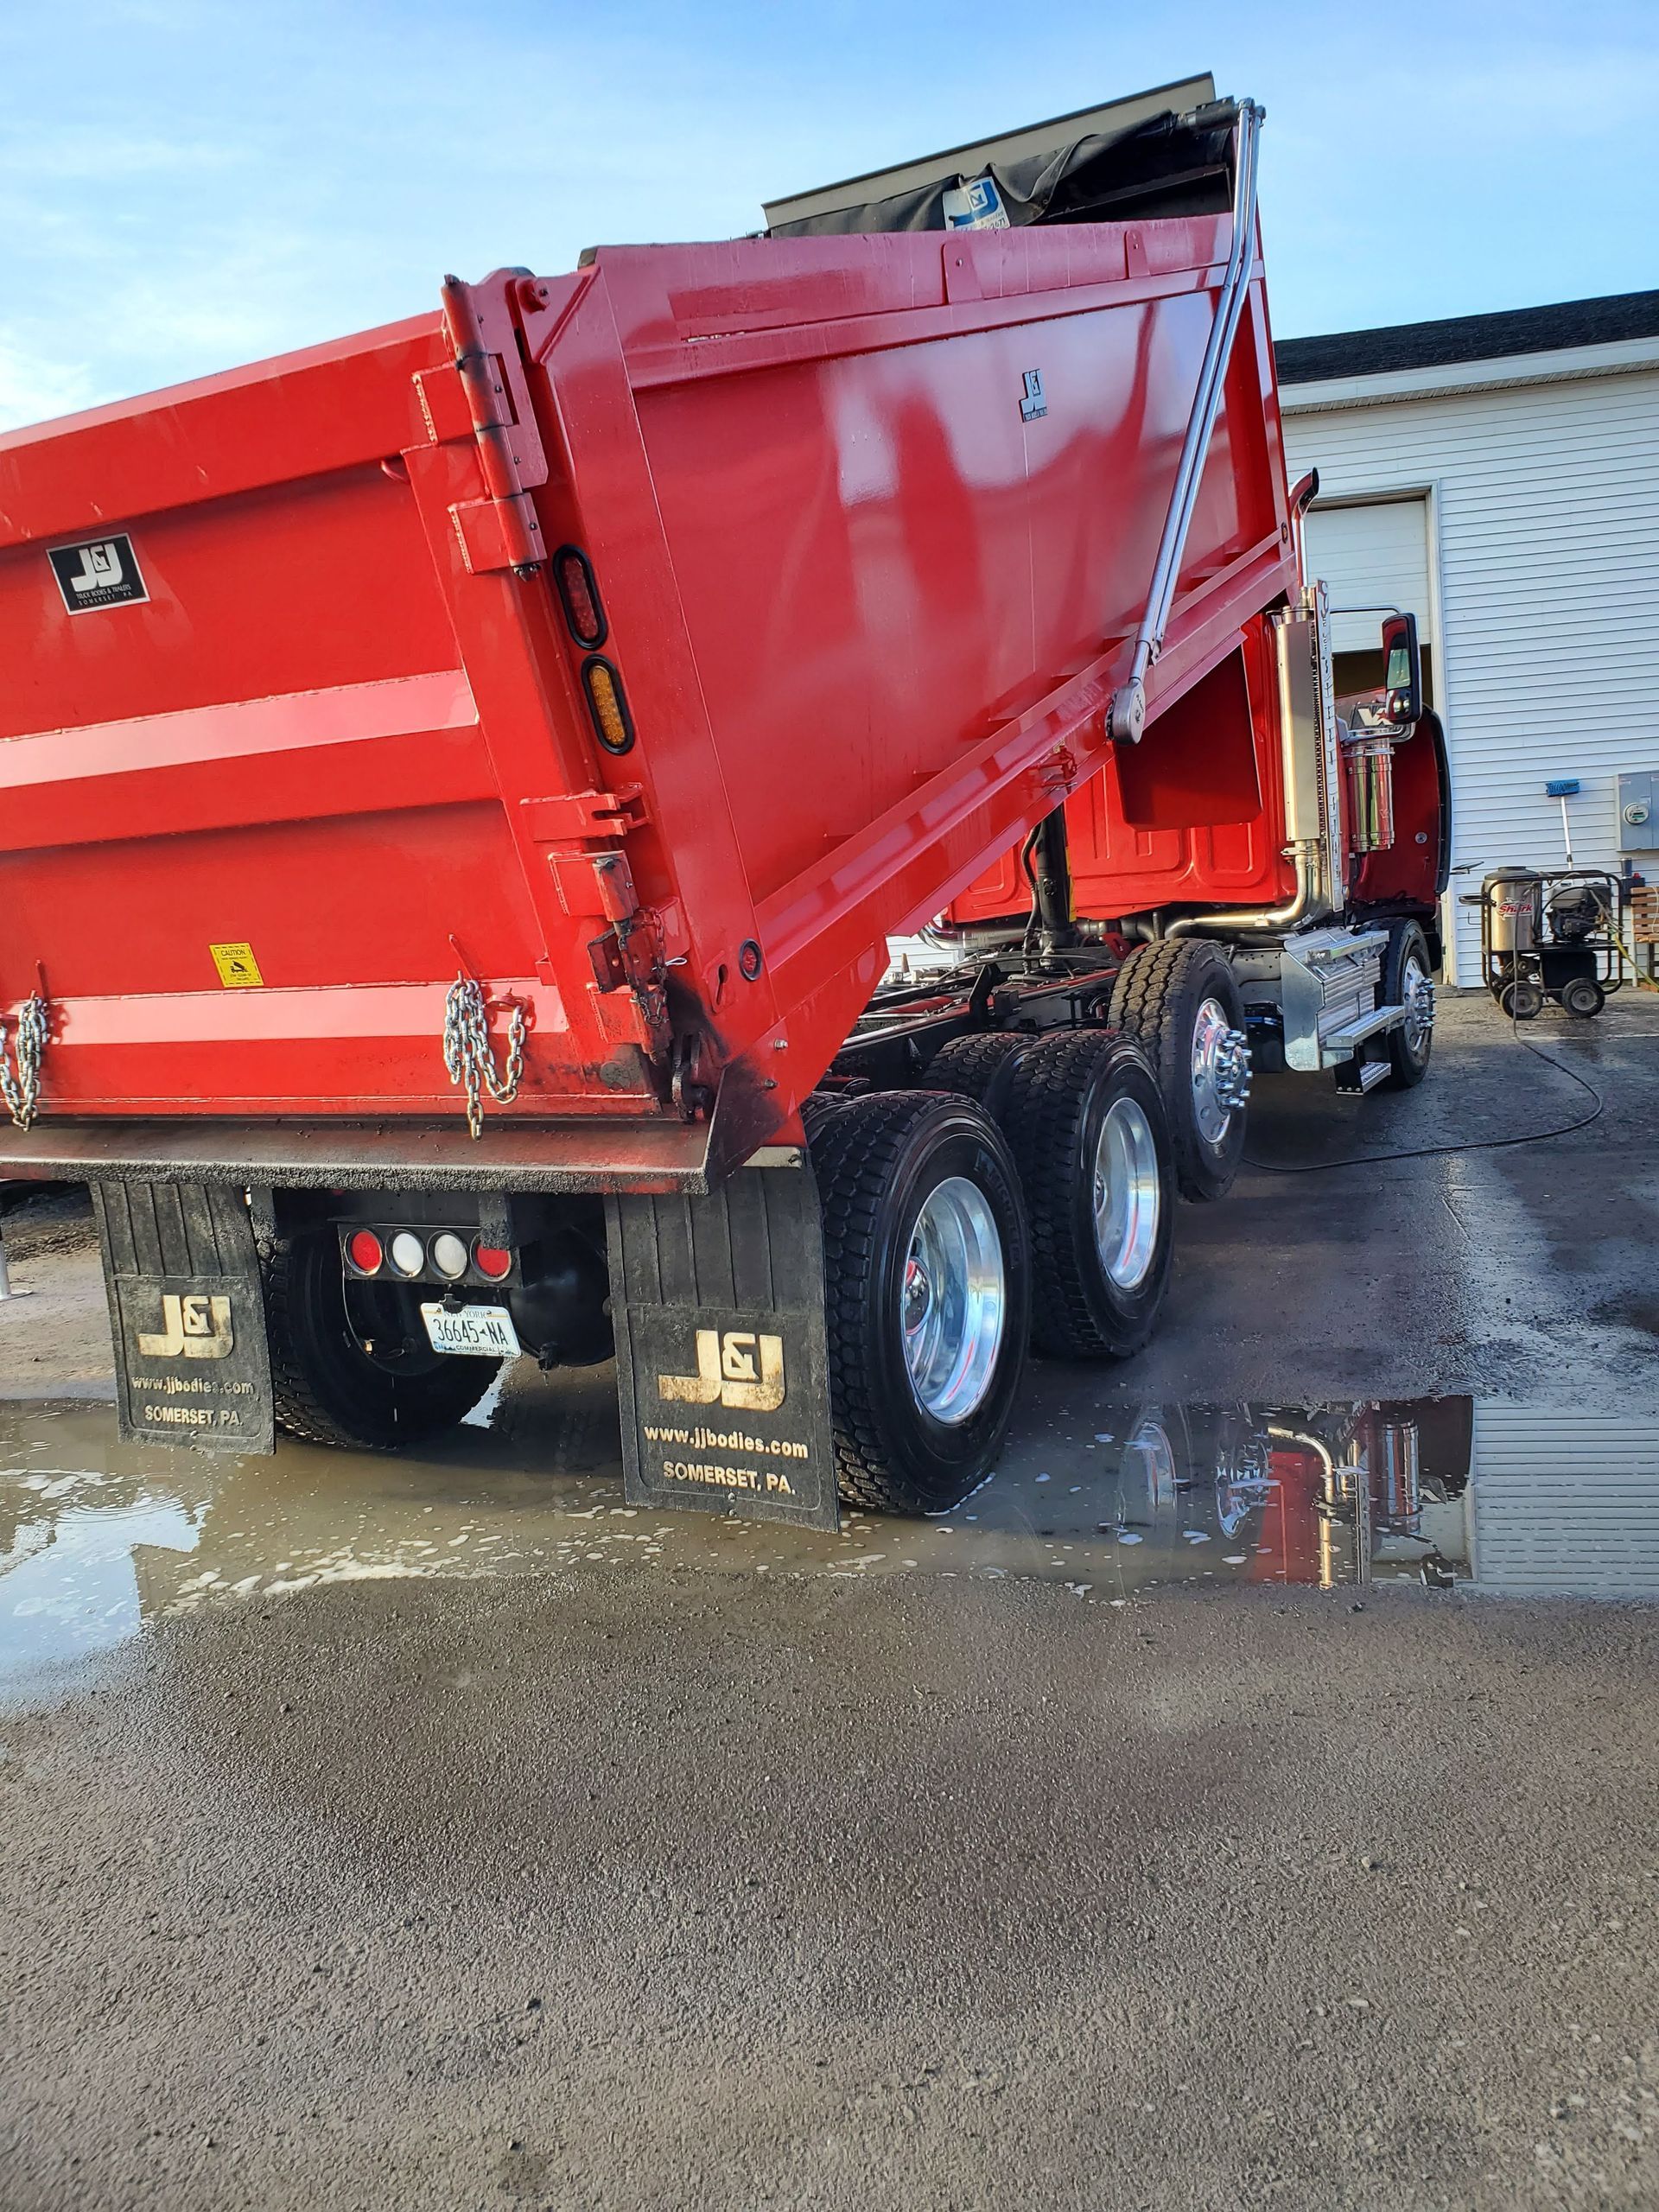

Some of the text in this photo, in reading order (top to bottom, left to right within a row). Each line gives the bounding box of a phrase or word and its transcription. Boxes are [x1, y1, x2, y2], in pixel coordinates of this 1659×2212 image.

[463, 1310, 487, 1319] YORK
[144, 1404, 244, 1427] SOMERSET, PA.
[644, 1426, 809, 1459] www.jjbodies.com
[663, 1460, 797, 1495] SOMERSET, PA.
